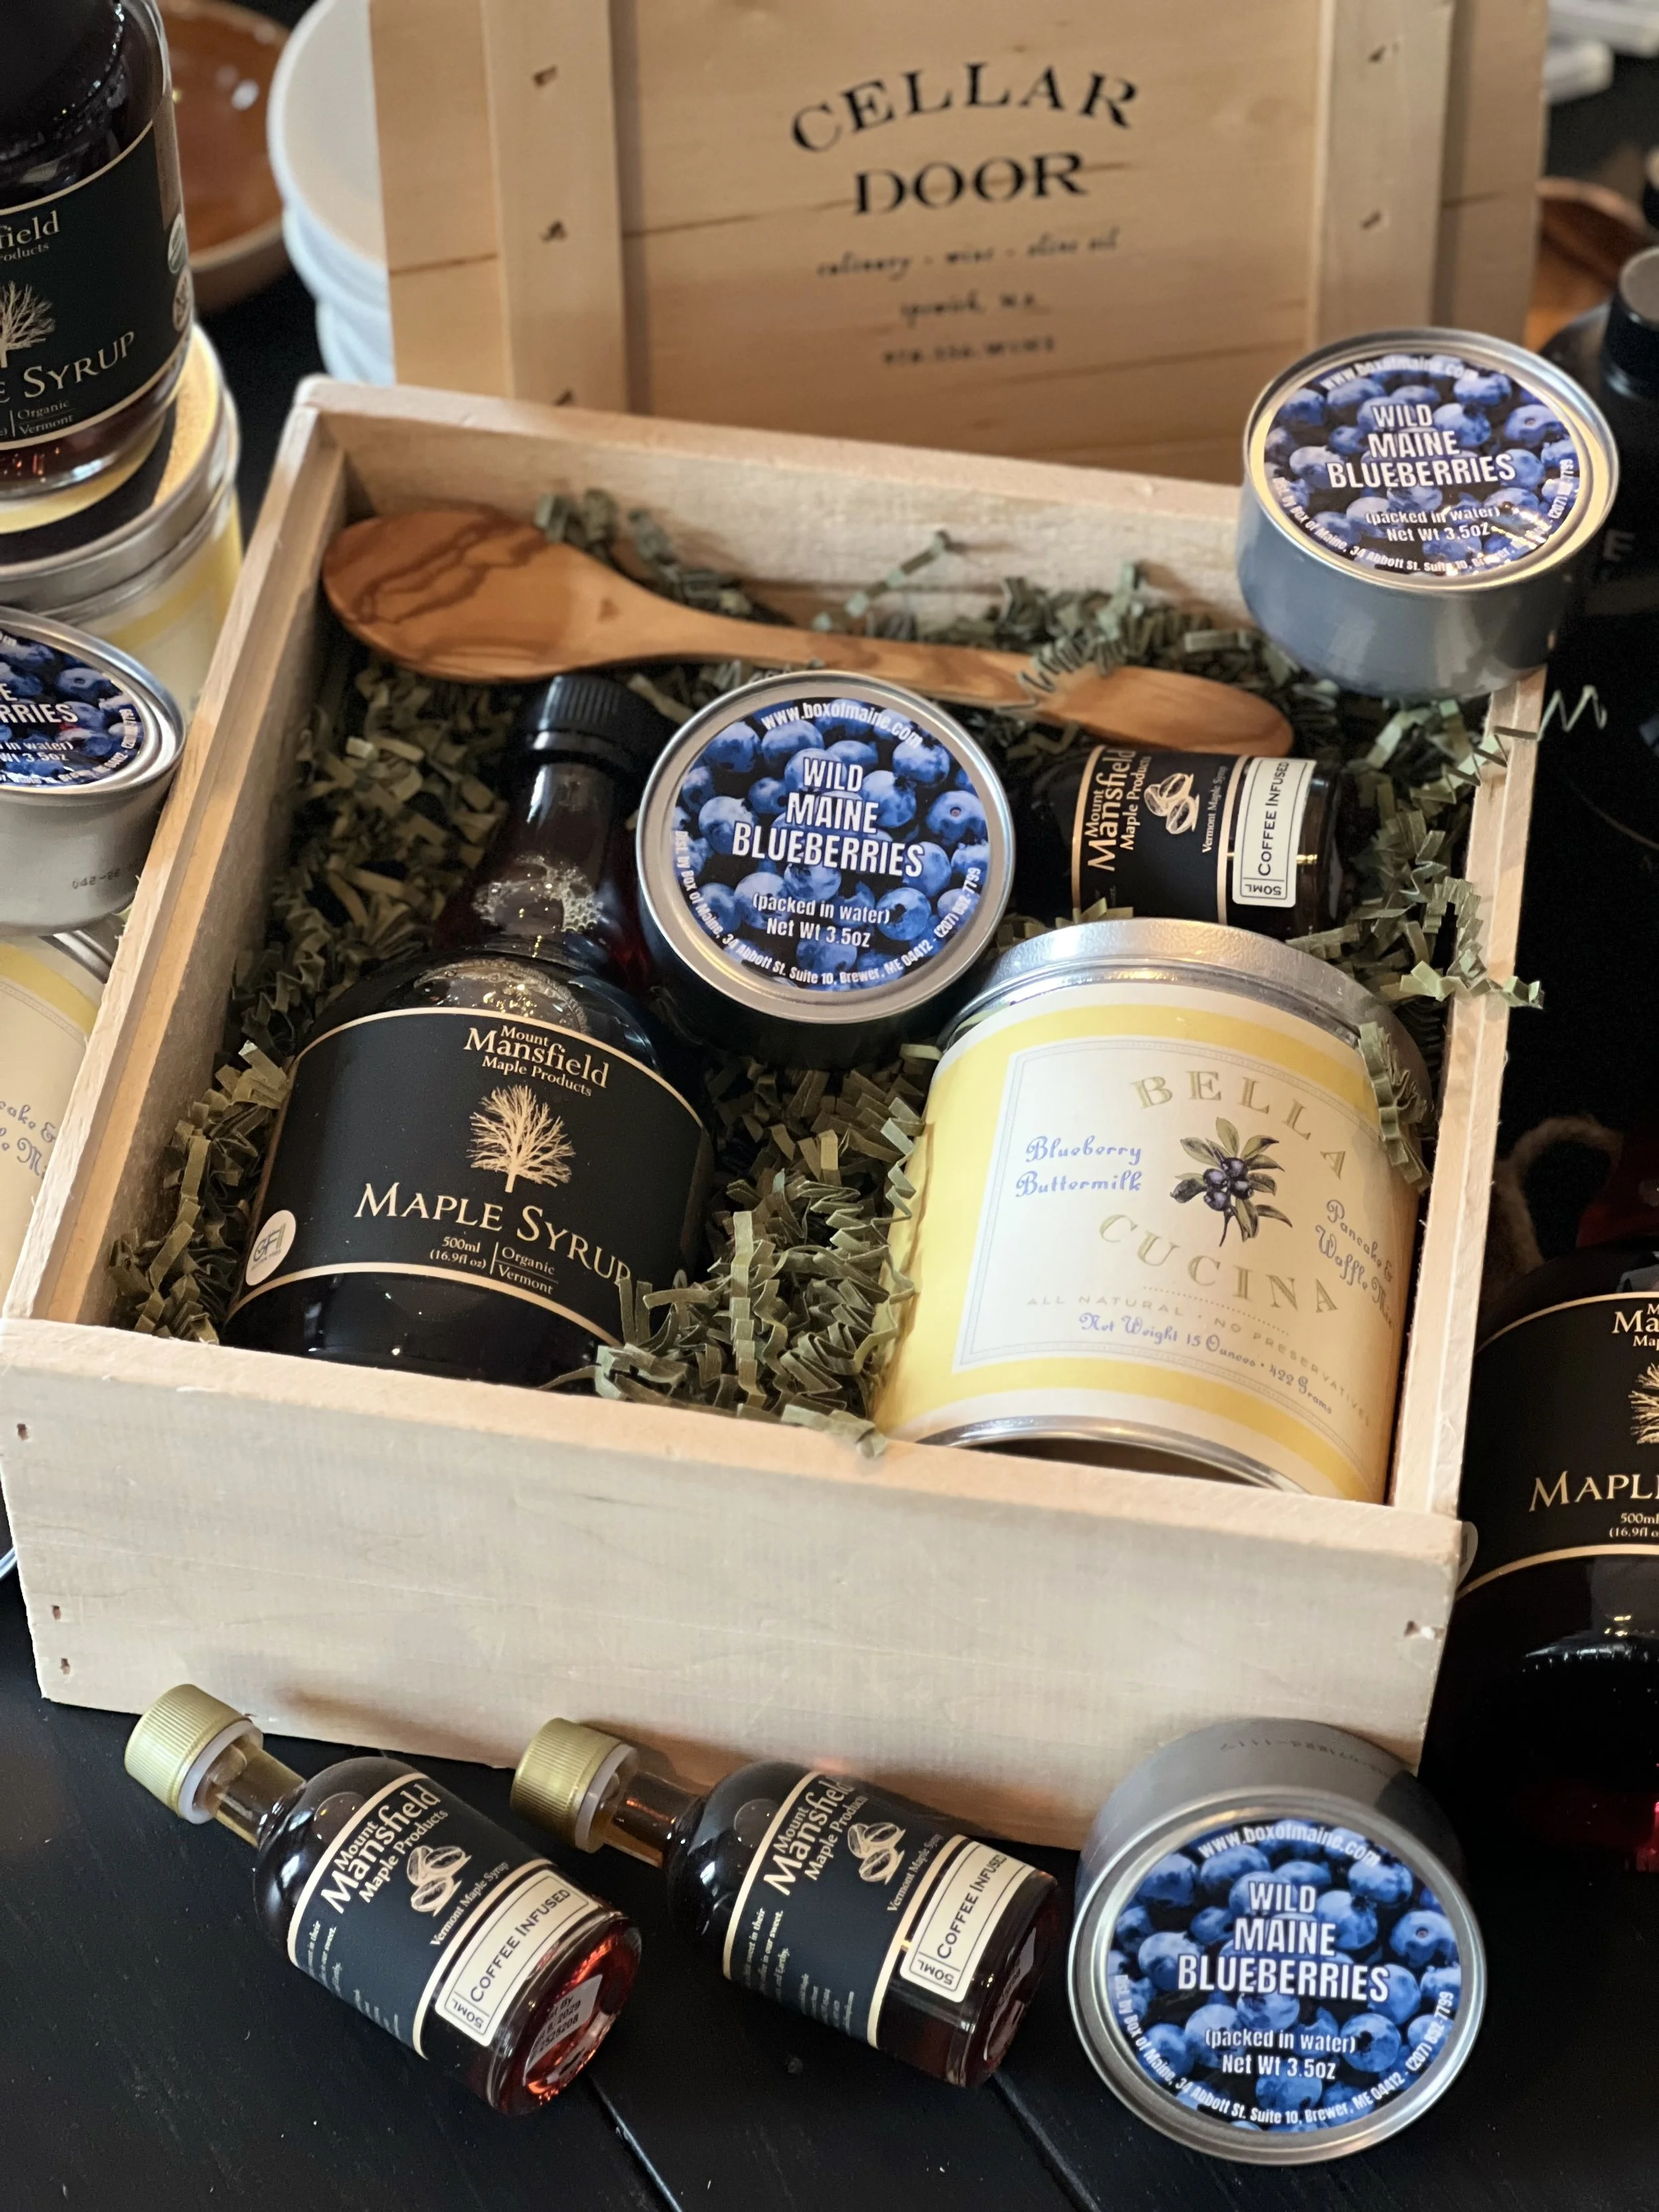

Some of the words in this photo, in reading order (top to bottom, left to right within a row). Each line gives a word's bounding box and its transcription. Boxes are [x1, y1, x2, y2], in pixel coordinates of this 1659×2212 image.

[790, 62, 1137, 153] CELLAR
[854, 150, 1090, 216] DOOR
[23, 331, 134, 399] SYRUP
[17, 399, 69, 420] Organic
[19, 413, 74, 436] Vermont
[1372, 404, 1433, 427] WILD
[1368, 430, 1460, 458] MAINE
[1327, 454, 1516, 488] BLUEBERRIES
[1366, 512, 1427, 526] (packed
[1431, 512, 1446, 524] in
[1451, 506, 1500, 521] water)
[1387, 528, 1415, 542] Net
[1418, 528, 1439, 542] Wt
[761, 702, 923, 749] www.boxofmaine.com
[803, 757, 863, 792] WILD
[1265, 761, 1289, 808] INFUSED
[786, 792, 879, 834] MAINE
[1084, 787, 1104, 838] Mount
[1086, 749, 1137, 871] Mansfield
[1208, 786, 1222, 811] Maple
[732, 822, 924, 877] BLUEBERRIES
[1120, 803, 1141, 851] Maple
[1202, 812, 1216, 853] Vermont
[1258, 810, 1277, 877] COFFEE
[753, 893, 816, 916] (packed
[820, 903, 835, 919] in
[839, 905, 890, 924] water)
[735, 944, 773, 970] Abbott
[788, 968, 818, 985] Suite
[883, 959, 903, 976] ME
[901, 939, 934, 966] 04412
[934, 913, 960, 938] (207)
[766, 917, 794, 937] Net
[800, 921, 820, 941] Wt
[826, 926, 871, 948] 3.5oz
[463, 1027, 609, 1088] Mansfield
[501, 1025, 549, 1047] Mount
[482, 1055, 528, 1075] Maple
[532, 1065, 593, 1097] Products
[1131, 1070, 1346, 1180] BELLA
[1025, 1135, 1142, 1165] Blueberry
[1015, 1170, 1143, 1197] Buttermilk
[354, 1182, 504, 1232] MAPLE
[516, 1205, 631, 1284] SYRUP
[441, 1236, 482, 1254] 500ml
[1326, 1199, 1382, 1268] Pancake
[498, 1263, 554, 1295] Vermont
[502, 1246, 556, 1276] Organic
[1099, 1213, 1338, 1313] CUCINA
[1315, 1224, 1368, 1291] Waffle
[1027, 1296, 1065, 1307] ALL
[1079, 1295, 1184, 1317] NATURAL
[1214, 1317, 1242, 1334] NO
[1079, 1311, 1115, 1332] Net
[1121, 1314, 1179, 1345] Weight
[1187, 1333, 1202, 1348] 15
[1205, 1334, 1257, 1368] Ounces
[1297, 1374, 1333, 1415] Grams
[321, 1783, 441, 1914] Mansfield
[335, 1821, 378, 1872] Mount
[763, 1777, 854, 1896] Mansfield
[772, 1805, 808, 1855] Mount
[1198, 1825, 1381, 1869] www.boxofmaine.com
[359, 1855, 398, 1904] Maple
[396, 1809, 448, 1857] Products
[804, 1835, 832, 1881] Maple
[429, 1905, 463, 1947] Vermont
[461, 1880, 489, 1911] Maple
[886, 1869, 912, 1912] Vermont
[1249, 1881, 1317, 1914] WILD
[469, 1935, 522, 2003] COFFEE
[515, 1889, 572, 1939] INFUSED
[936, 1893, 975, 1960] COFFEE
[1234, 1917, 1336, 1957] MAINE
[1177, 1954, 1390, 2003] BLUEBERRIES
[1204, 2028, 1274, 2048] (packed
[1279, 2031, 1294, 2049] in
[1300, 2034, 1356, 2053] water)
[1123, 2014, 1142, 2039] Box
[1143, 2048, 1177, 2085] Maine,
[1175, 2077, 1195, 2094] 34
[1189, 2085, 1230, 2114] Abbott
[1230, 2102, 1246, 2119] St.
[1250, 2107, 1282, 2124] Suite
[1285, 2110, 1303, 2125] 10,
[1305, 2103, 1354, 2122] Brewer,
[1351, 2094, 1374, 2111] ME
[1370, 2071, 1406, 2101] 04412
[1406, 2042, 1433, 2072] (207)
[1222, 2054, 1252, 2075] Net
[1258, 2055, 1281, 2076] Wt
[1287, 2059, 1336, 2081] 3.5oz
